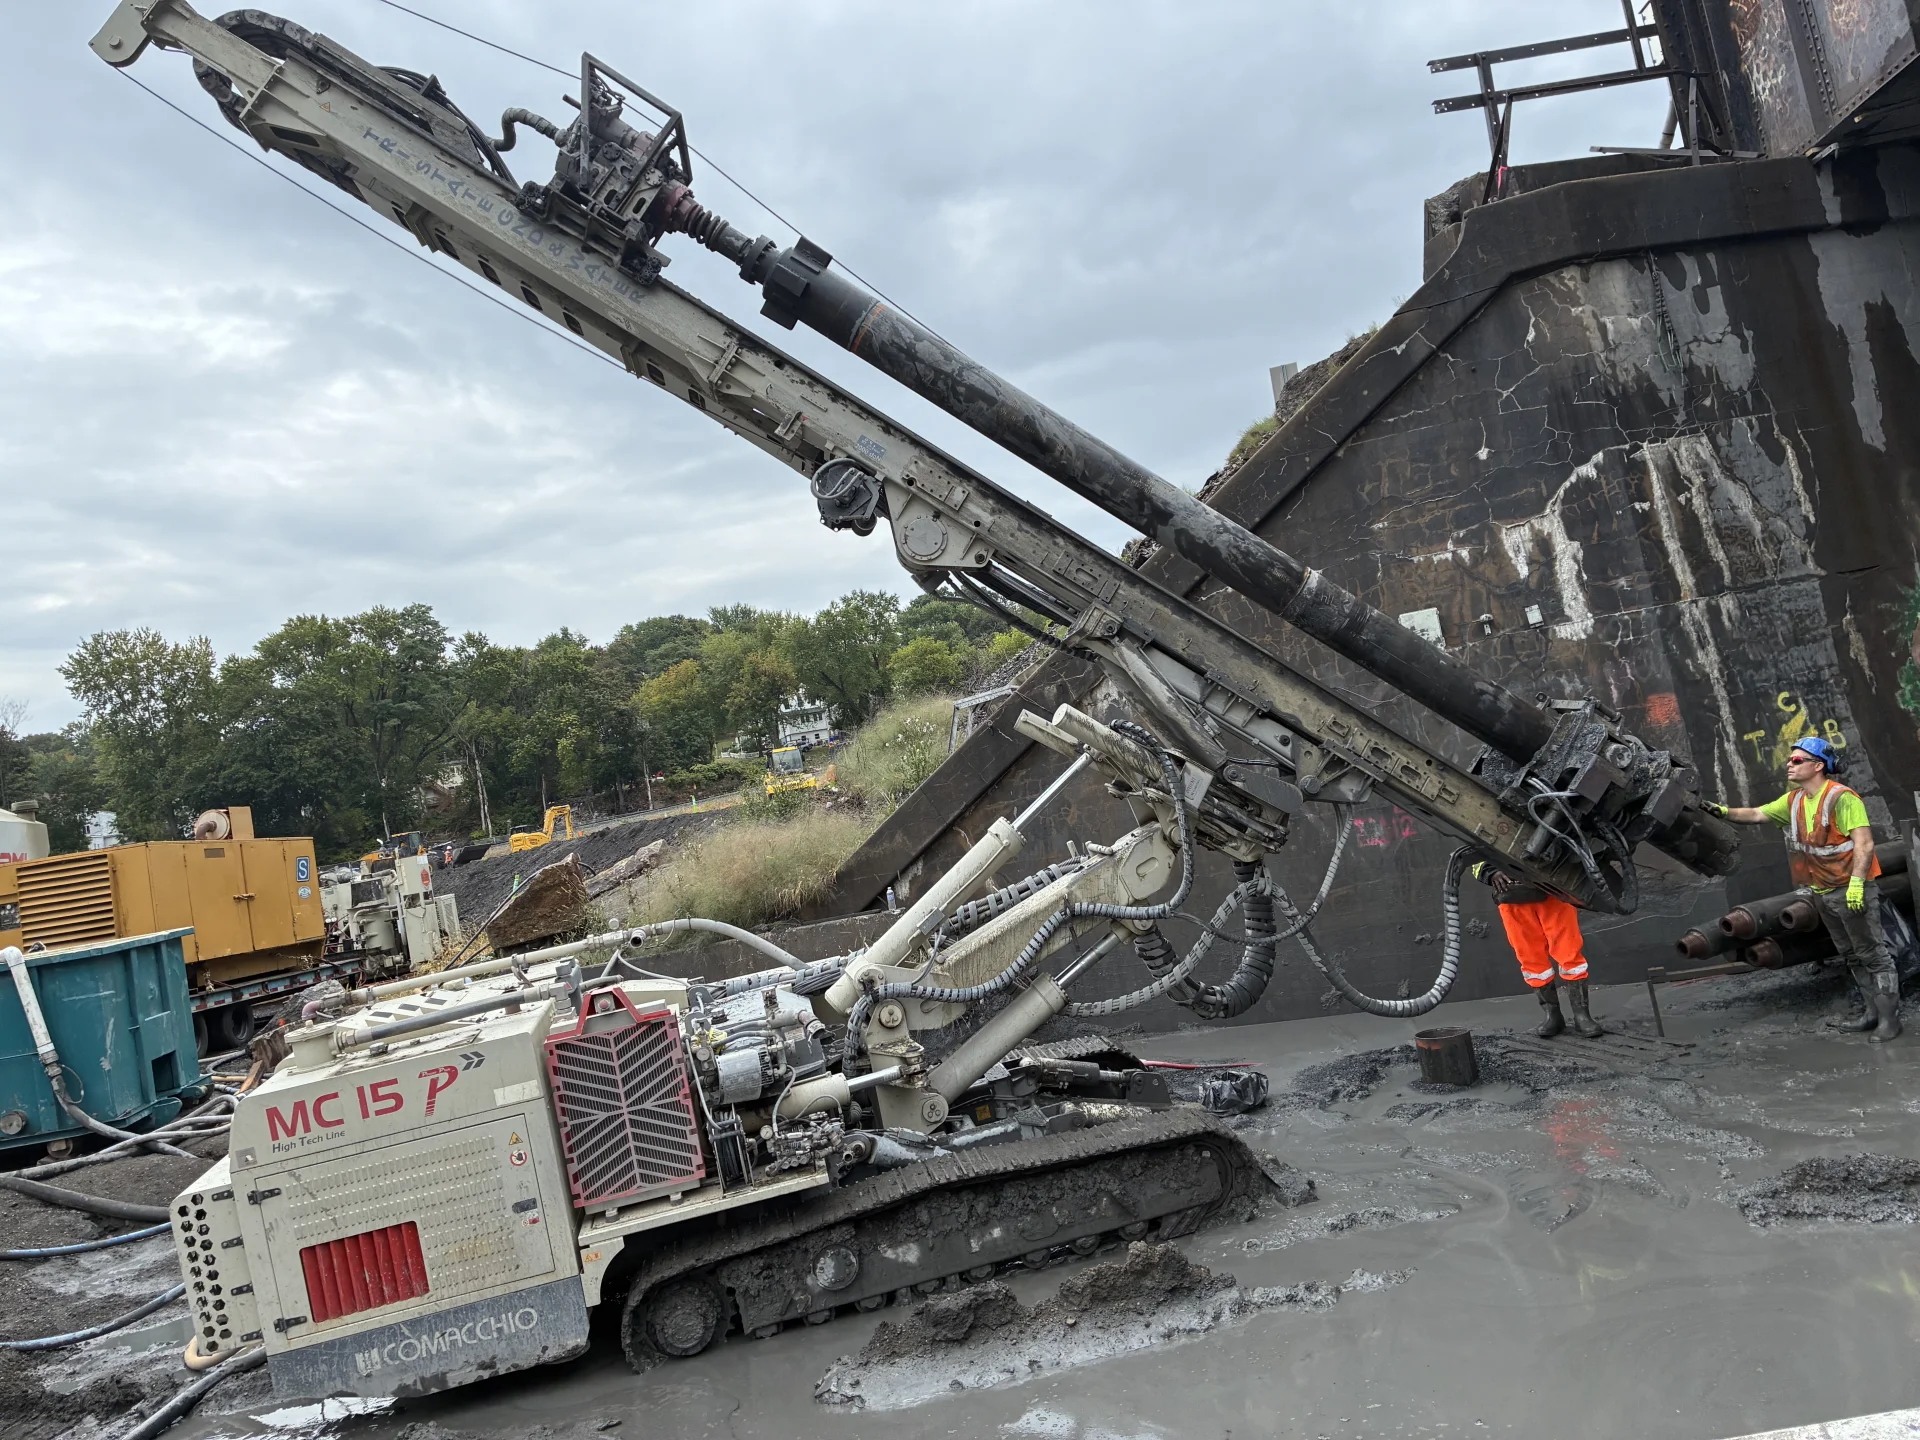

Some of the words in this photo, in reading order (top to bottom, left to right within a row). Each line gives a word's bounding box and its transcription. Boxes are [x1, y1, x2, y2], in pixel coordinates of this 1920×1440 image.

[362, 127, 410, 160] TRI
[416, 159, 494, 213] STATE
[497, 208, 544, 246] GND
[548, 241, 566, 257] &
[565, 247, 646, 305] WATER
[1743, 729, 1766, 762] T
[1823, 718, 1847, 749] B
[298, 859, 308, 879] S
[265, 1092, 345, 1142] MC
[356, 1077, 404, 1120] 15
[417, 1065, 459, 1118] P
[272, 1141, 297, 1154] High
[298, 1134, 324, 1148] Tech
[325, 1129, 346, 1143] Line
[383, 1308, 538, 1362] COMACCHIO
